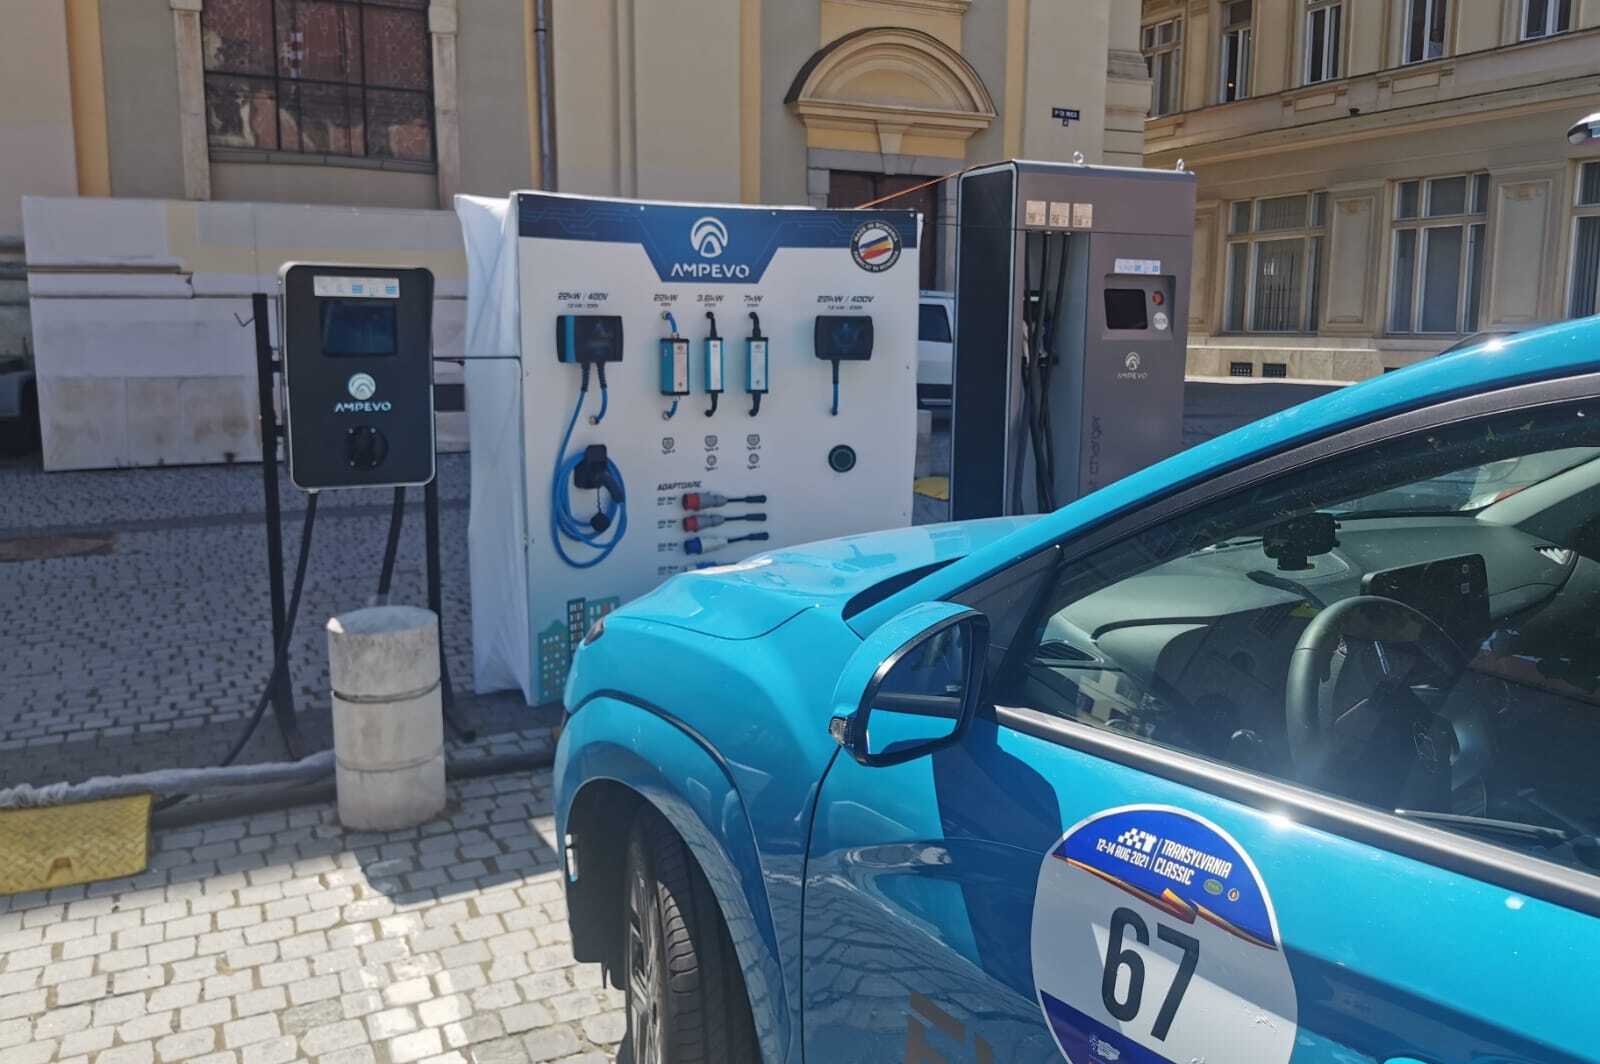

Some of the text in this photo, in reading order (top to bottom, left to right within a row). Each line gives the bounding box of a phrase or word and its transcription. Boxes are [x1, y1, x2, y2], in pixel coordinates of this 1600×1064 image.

[671, 262, 750, 278] AMPEVO
[335, 401, 392, 412] AMPEVO
[1096, 838, 1150, 868] 12-14 AUG 2021
[1161, 839, 1232, 879] TRANSYLVANIA
[1153, 857, 1195, 885] CLASSIC
[1102, 907, 1199, 1042] 67
